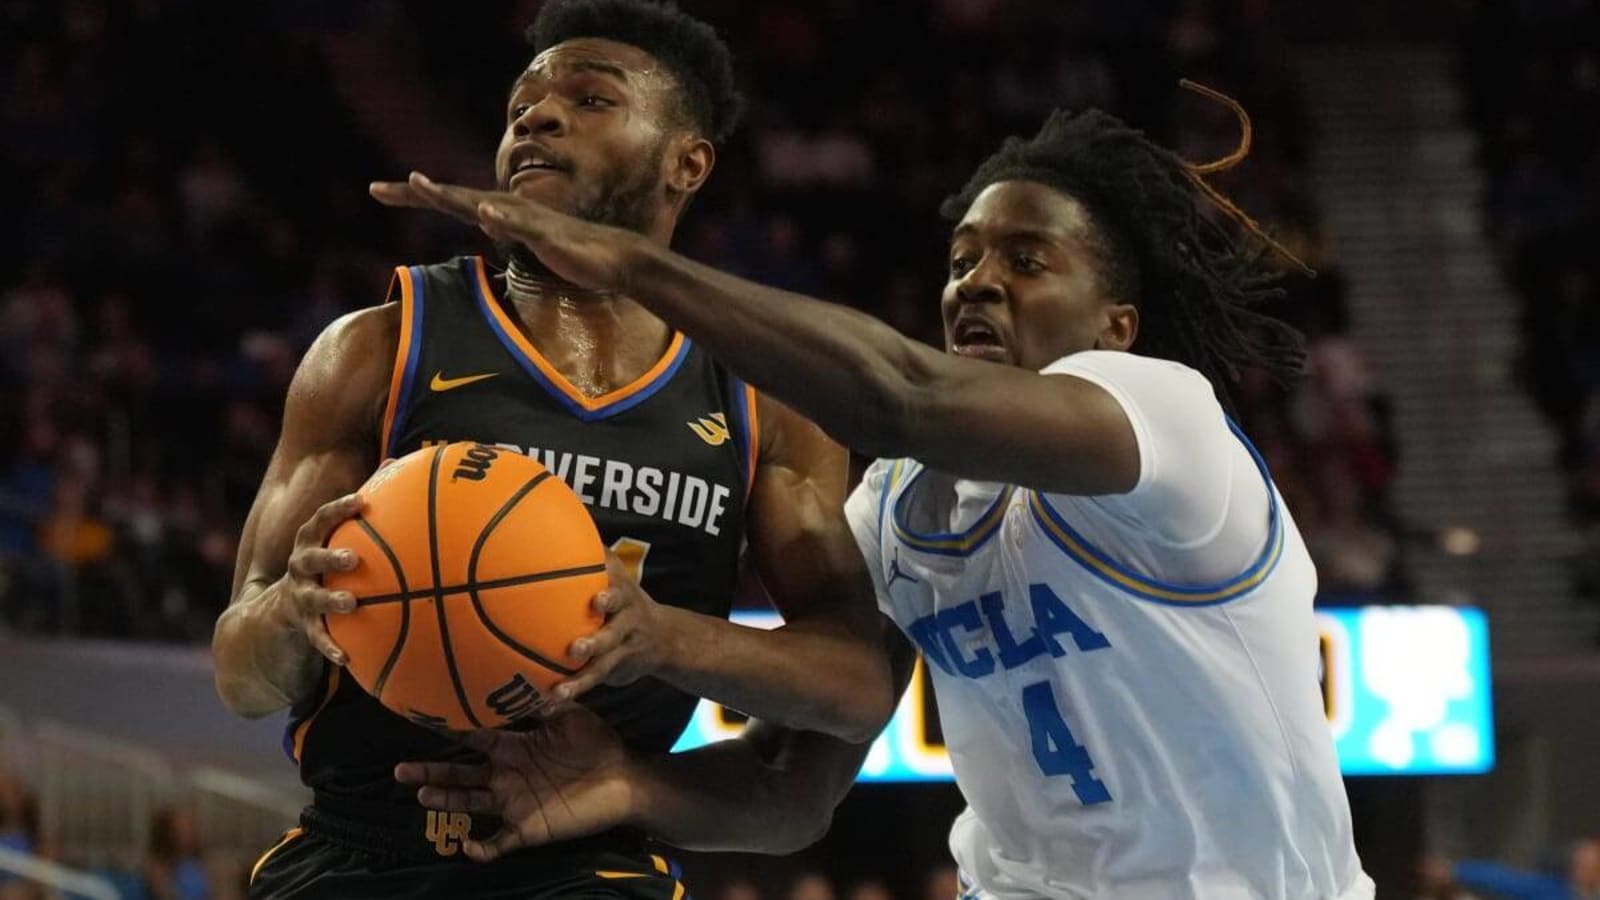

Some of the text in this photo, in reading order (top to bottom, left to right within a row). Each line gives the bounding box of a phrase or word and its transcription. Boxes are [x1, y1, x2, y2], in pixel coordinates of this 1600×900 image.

[495, 442, 730, 536] VERSIDE
[907, 583, 1112, 680] UCLA
[1022, 680, 1114, 806] 4
